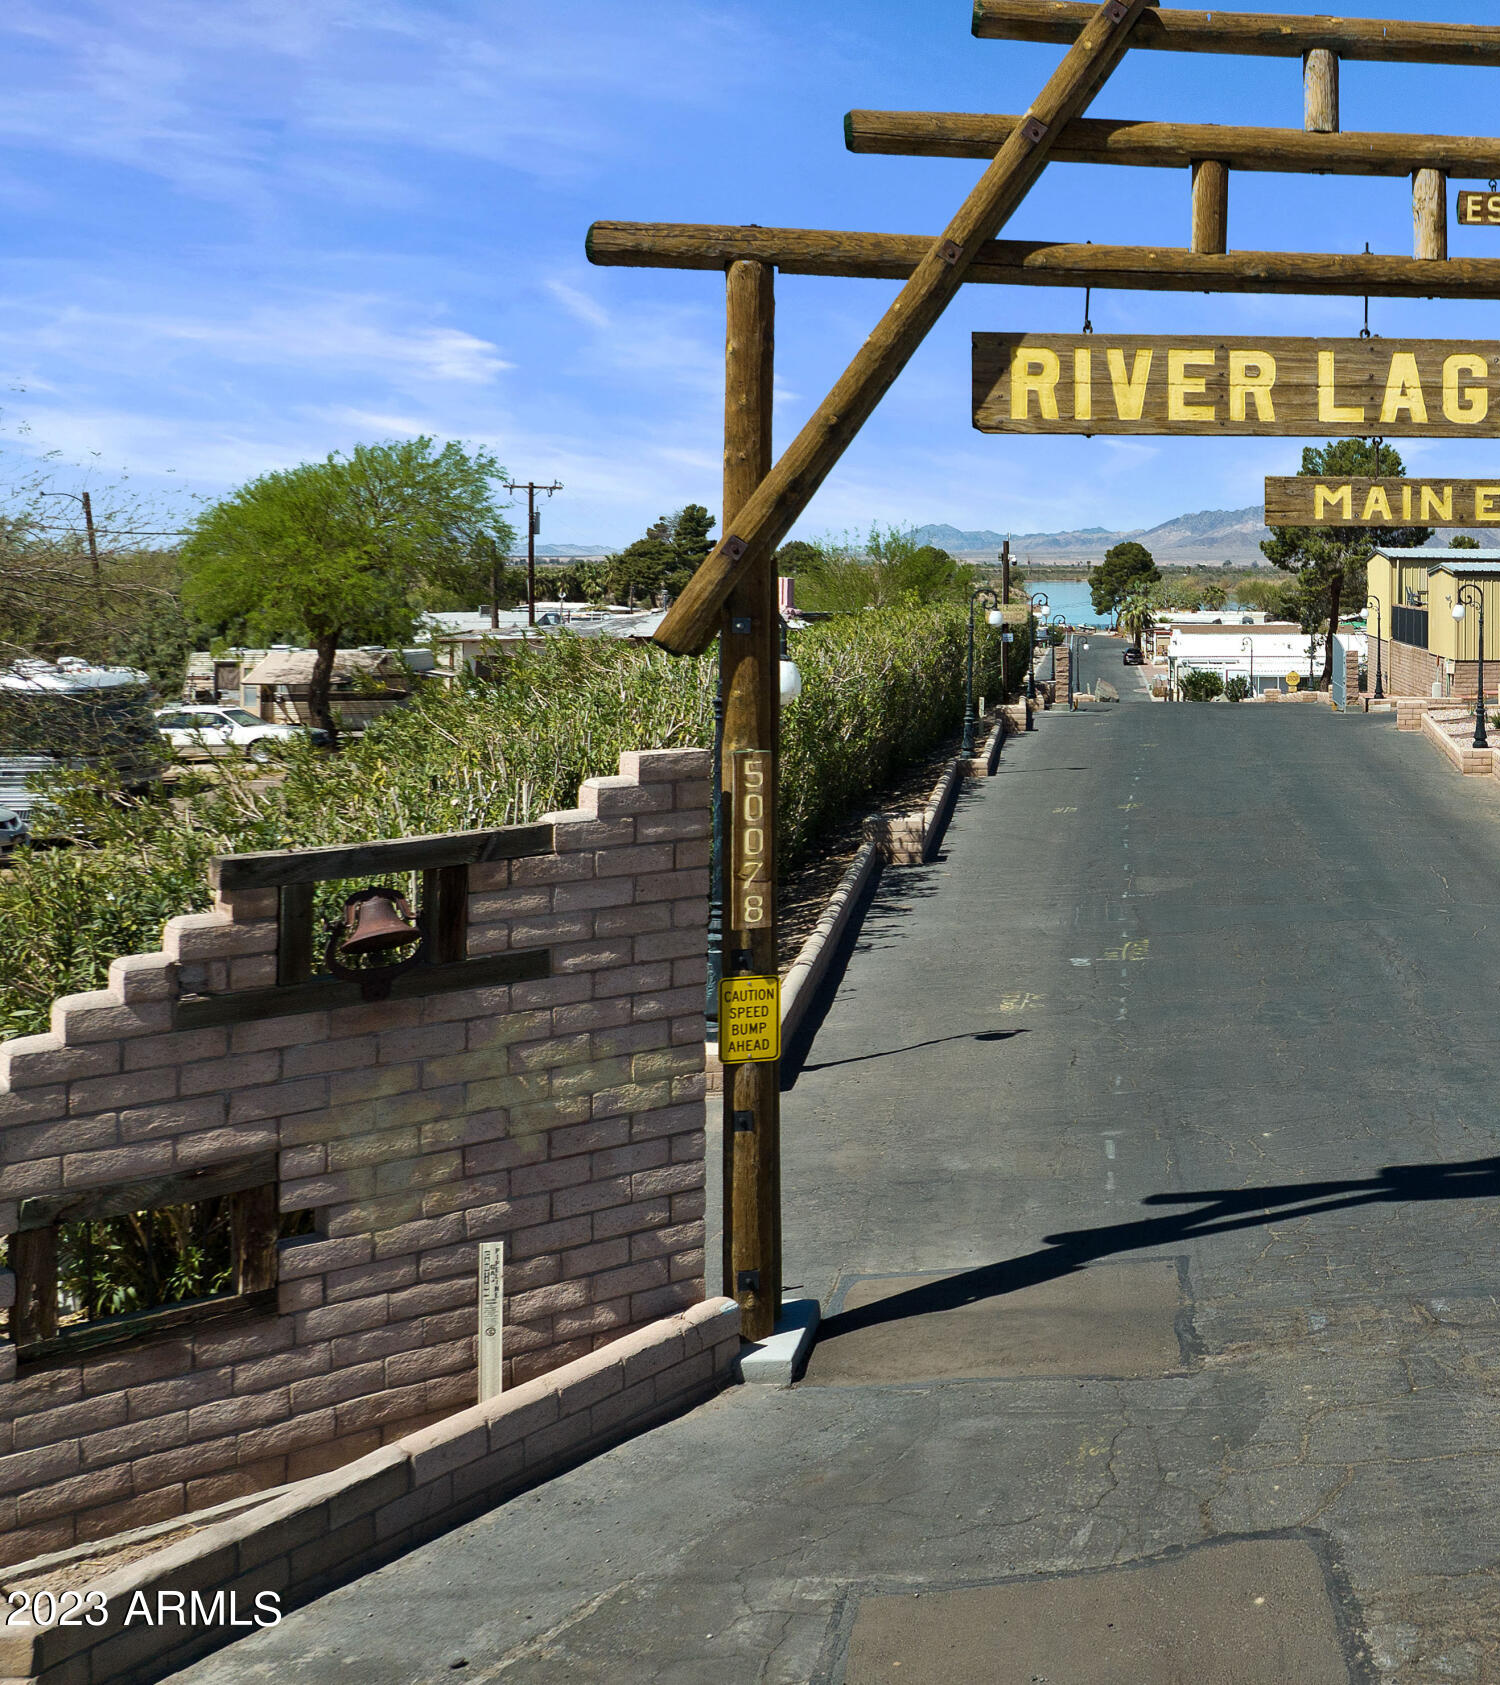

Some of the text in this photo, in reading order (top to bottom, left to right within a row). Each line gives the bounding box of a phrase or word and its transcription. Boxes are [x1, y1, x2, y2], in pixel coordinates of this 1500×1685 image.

[1010, 347, 1276, 422] RIVER
[1315, 484, 1453, 520] MAIN
[743, 760, 764, 923] 50078
[724, 989, 774, 1003] CAUTION
[729, 1006, 769, 1019] SPEED
[732, 1022, 767, 1036] BUMP
[728, 1039, 770, 1053] AHEAD
